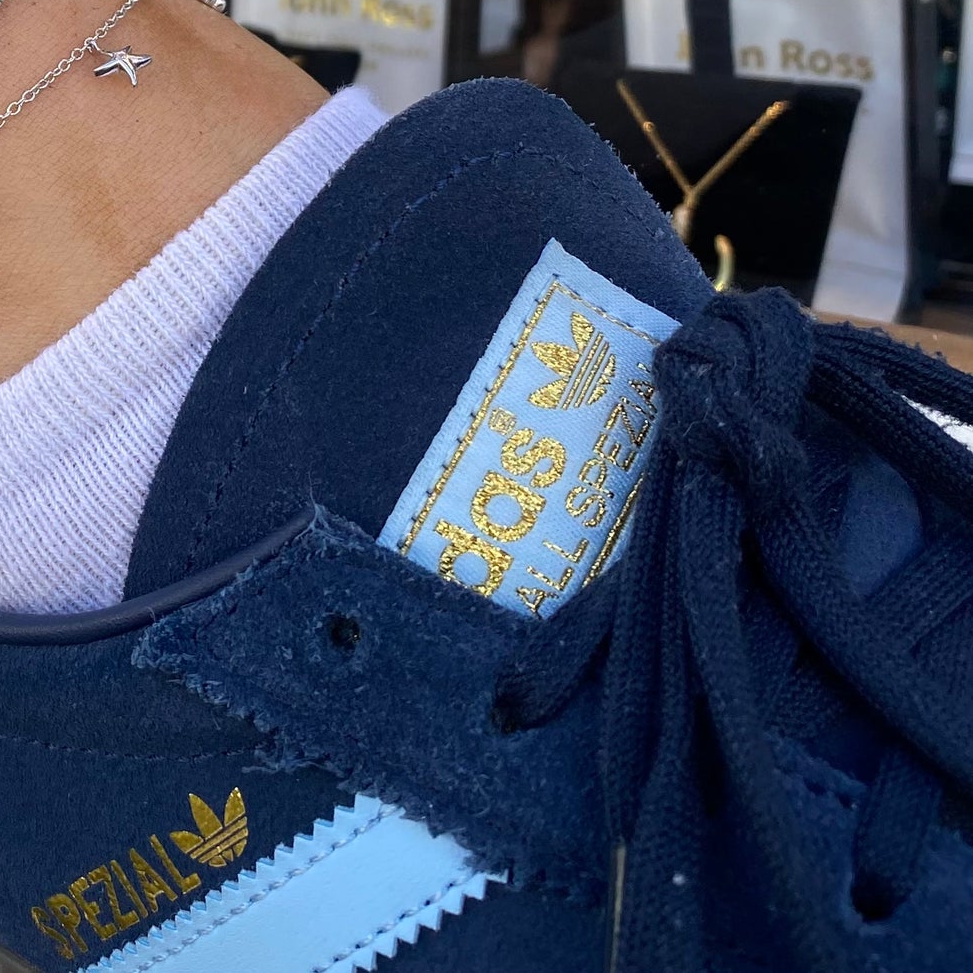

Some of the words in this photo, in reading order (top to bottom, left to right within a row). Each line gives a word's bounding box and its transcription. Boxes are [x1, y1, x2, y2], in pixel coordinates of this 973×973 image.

[779, 38, 874, 80] Ross
[565, 362, 659, 528] SPEZIA
[30, 833, 202, 960] SPEZIAL
